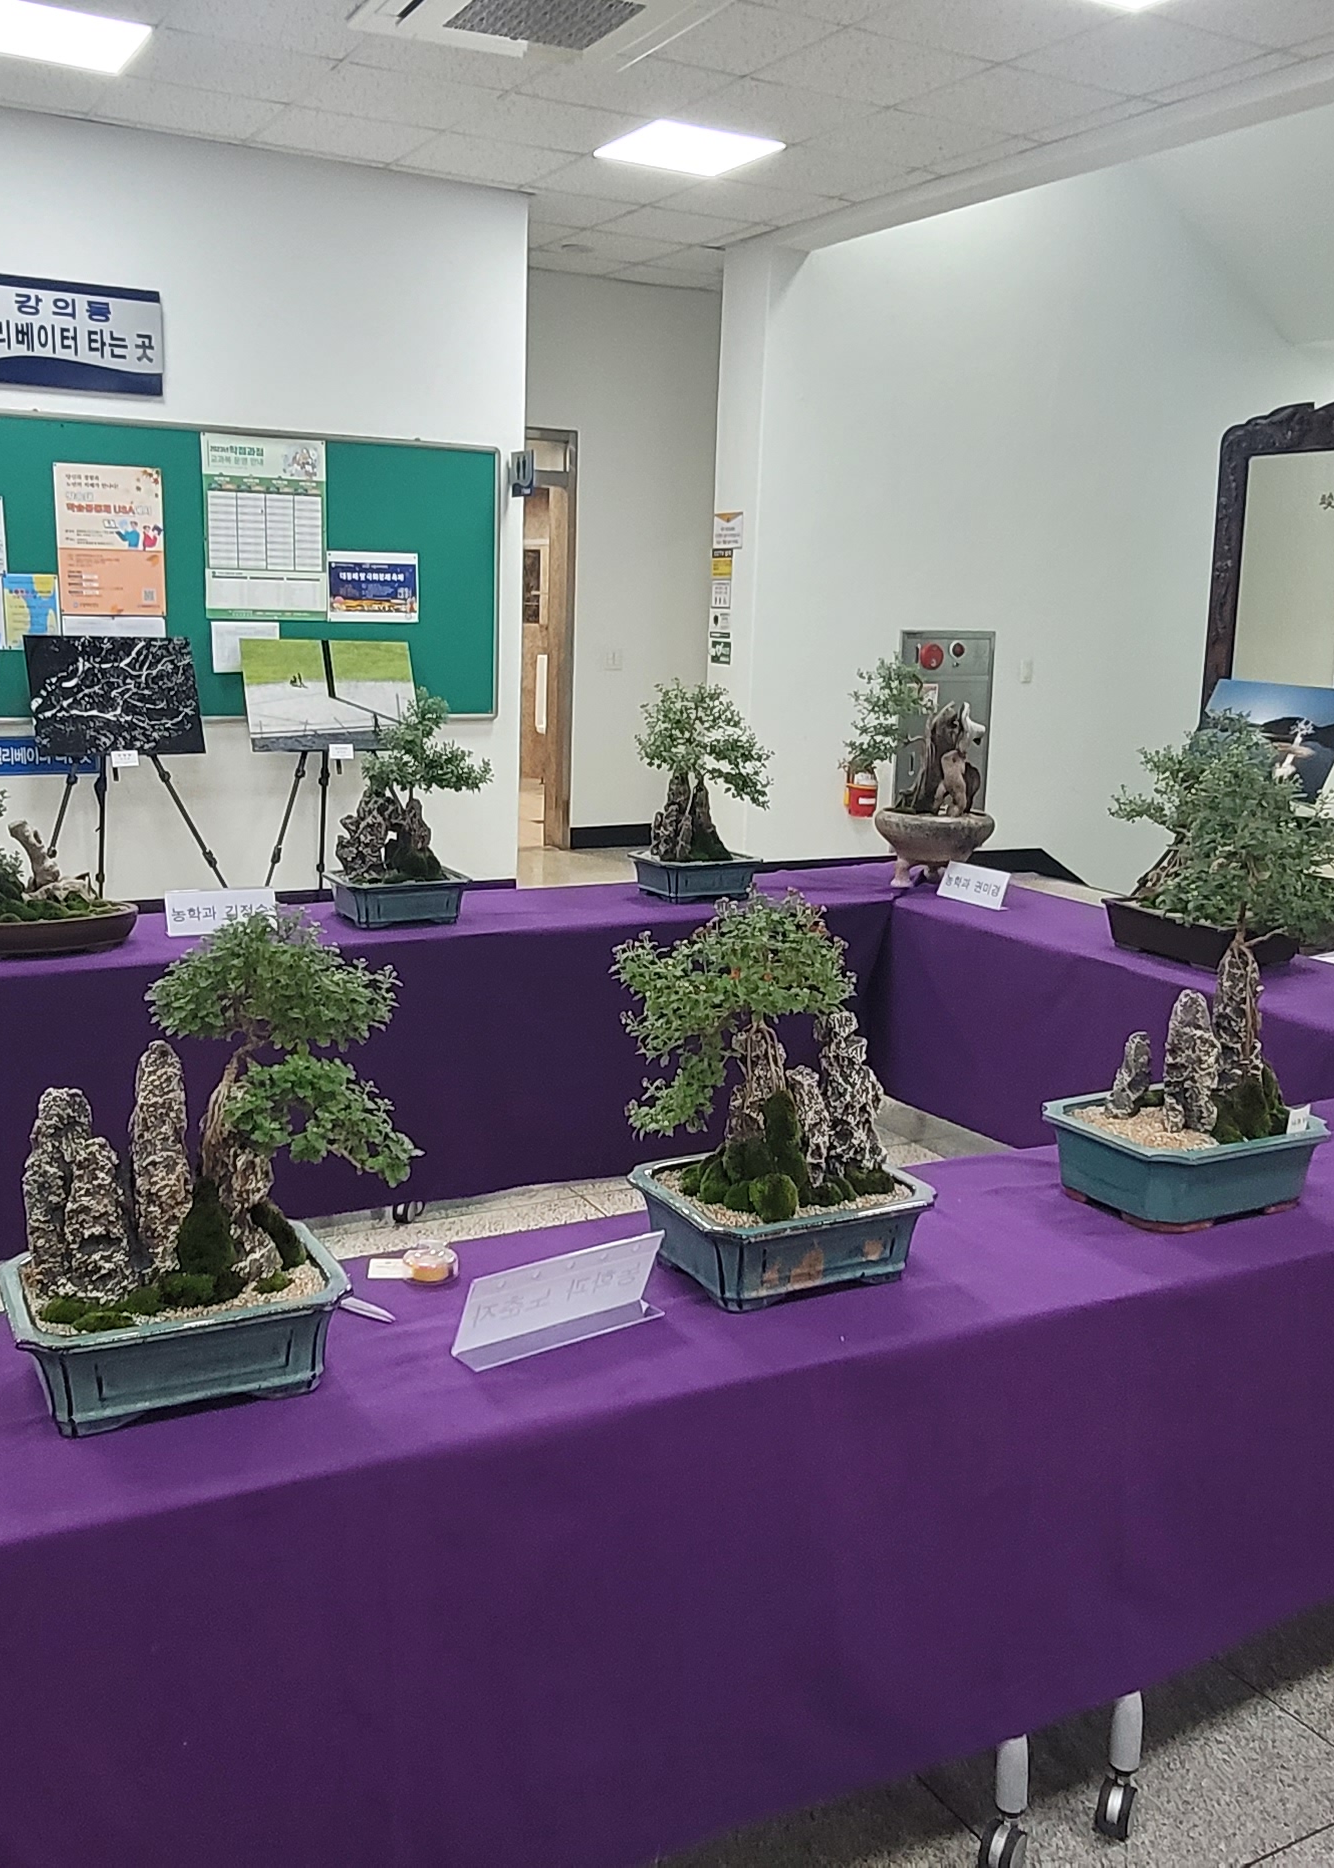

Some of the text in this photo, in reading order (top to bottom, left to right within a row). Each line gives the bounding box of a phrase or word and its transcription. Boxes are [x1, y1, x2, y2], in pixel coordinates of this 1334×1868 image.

[87, 329, 129, 360] 타는
[134, 333, 155, 363] 곳
[171, 905, 216, 923] 농학과
